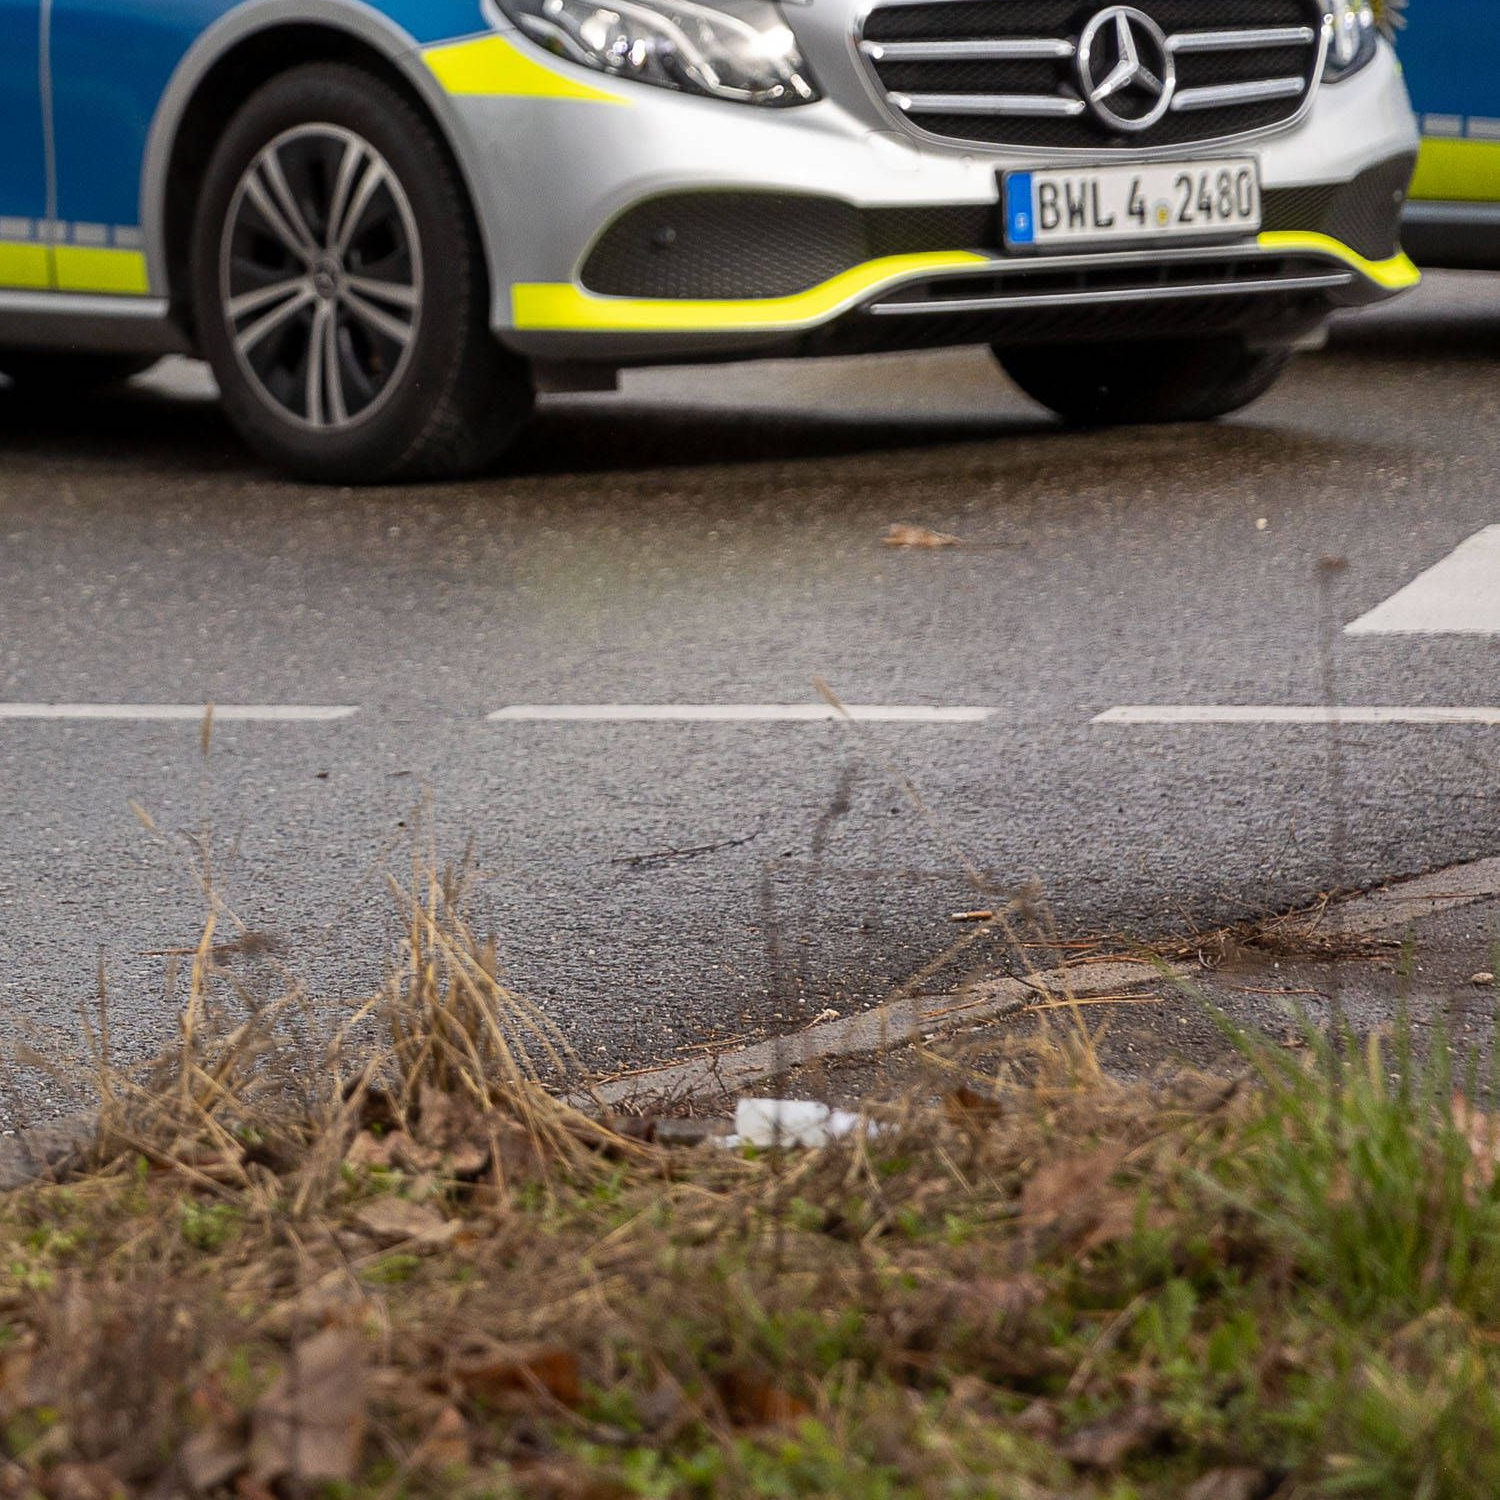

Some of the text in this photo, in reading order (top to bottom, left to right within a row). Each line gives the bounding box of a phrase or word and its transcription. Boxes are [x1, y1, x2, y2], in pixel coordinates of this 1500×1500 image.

[1038, 169, 1251, 230] BWL 4 2480
